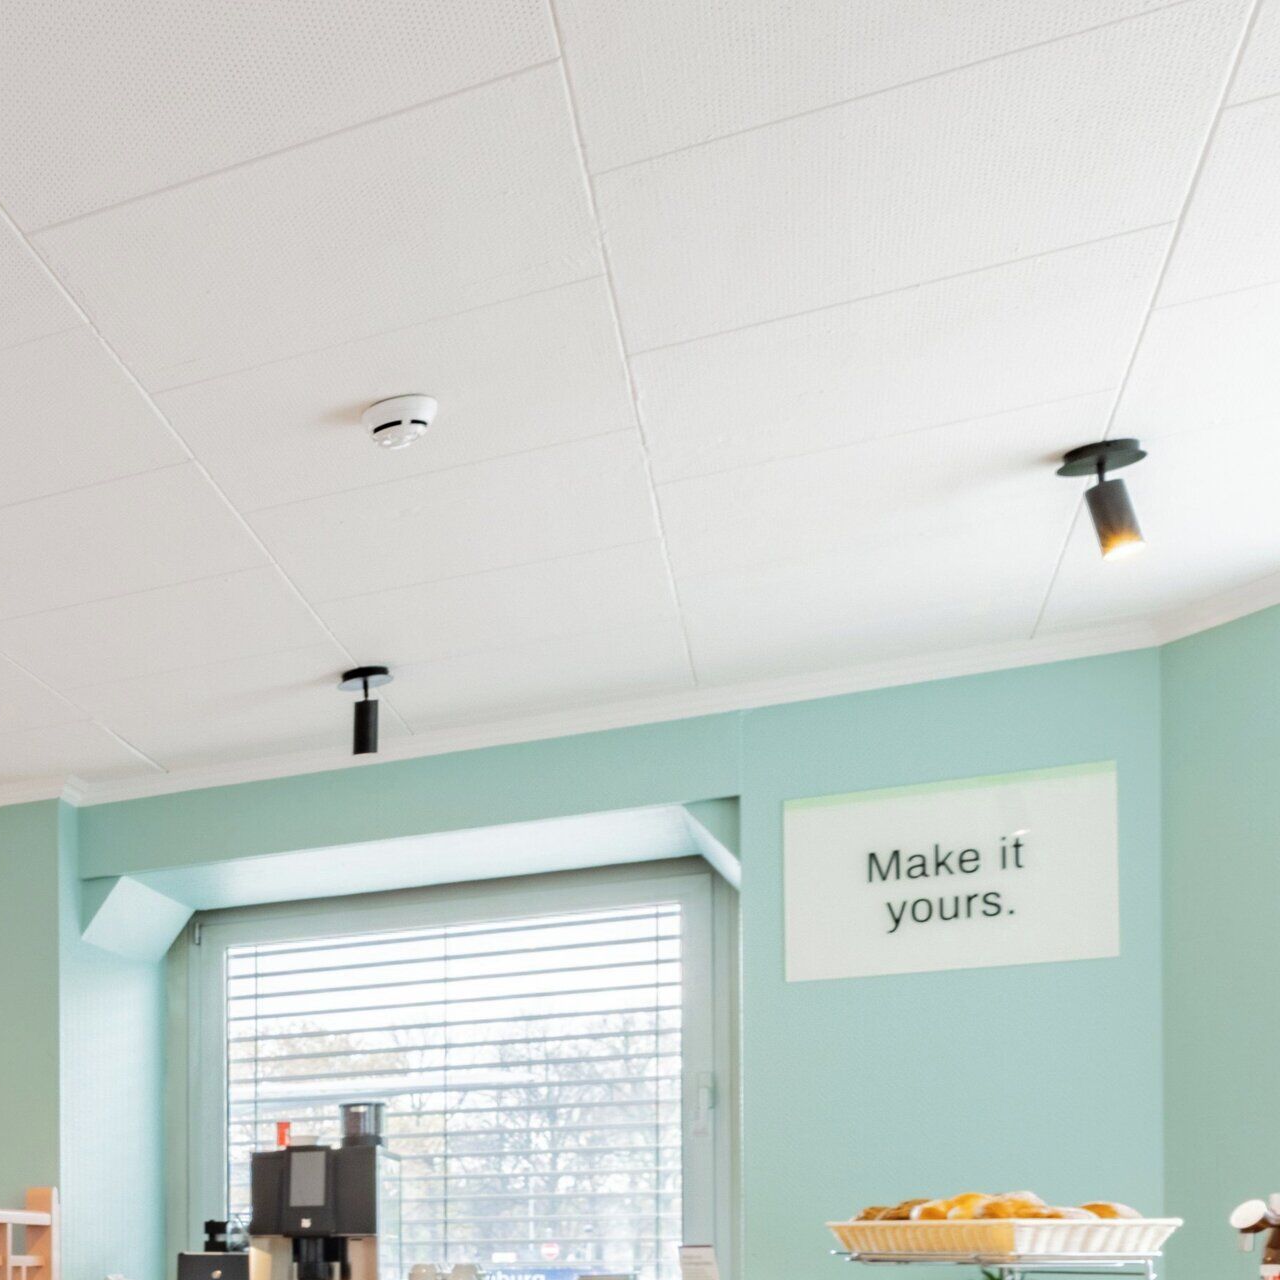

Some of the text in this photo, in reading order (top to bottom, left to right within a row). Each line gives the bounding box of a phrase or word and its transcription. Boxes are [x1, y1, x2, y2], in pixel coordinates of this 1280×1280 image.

[867, 837, 1025, 883] Make it
[886, 891, 1015, 934] yours.
